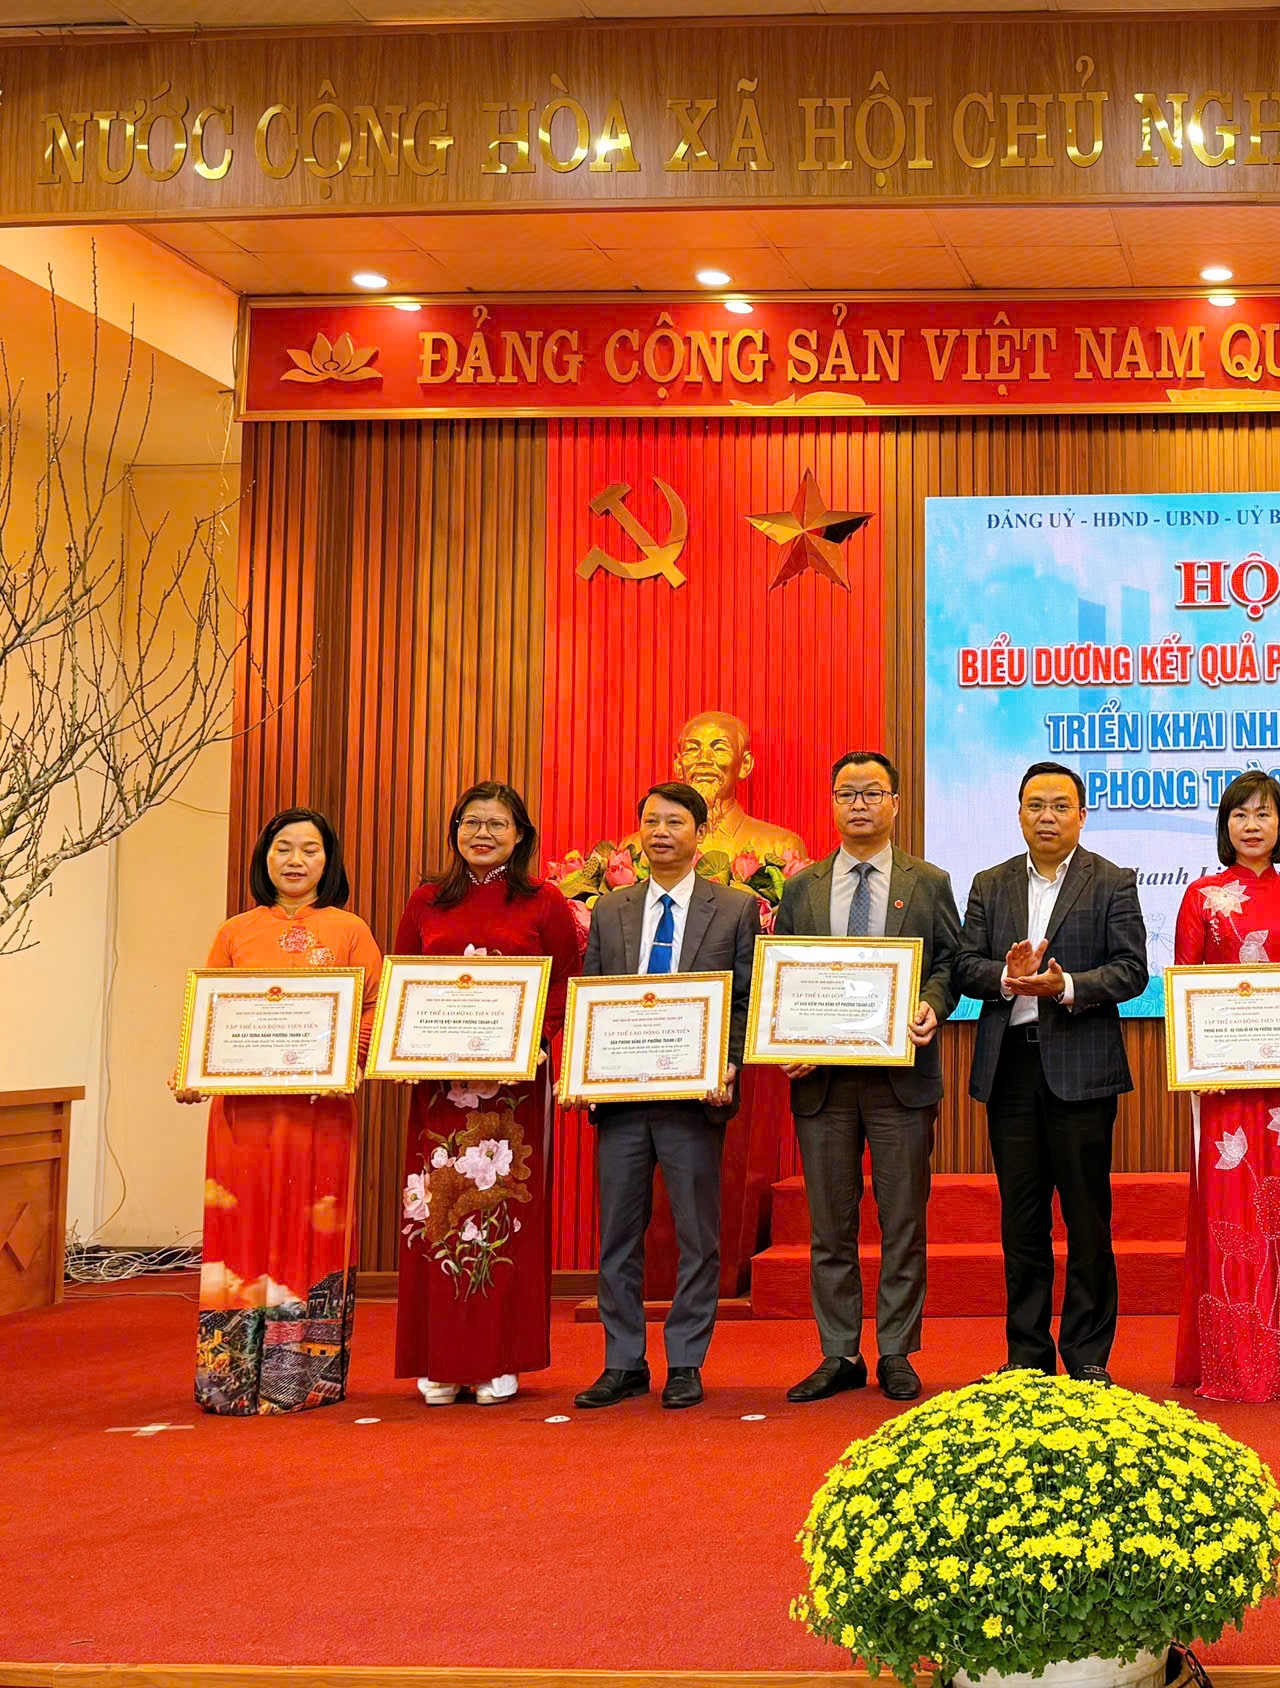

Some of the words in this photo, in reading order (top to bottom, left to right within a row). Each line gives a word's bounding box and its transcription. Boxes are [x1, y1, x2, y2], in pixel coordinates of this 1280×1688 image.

[37, 80, 234, 185] NƯỚC
[255, 79, 456, 200] CỘNG
[480, 74, 642, 175] HÒA
[664, 77, 775, 173] XÃ
[799, 70, 934, 189] HỘI
[953, 55, 1109, 168] CHỦ
[417, 305, 585, 385] ĐẢNG
[604, 311, 770, 398] CỘNG
[787, 302, 906, 383] SẢN
[921, 311, 1057, 397] VIỆT
[1075, 325, 1206, 379] NAM
[987, 509, 1043, 529] ĐẢNG
[1049, 507, 1076, 528] UỶ
[1092, 511, 1149, 527] HĐND
[1166, 510, 1220, 526] UBND
[1236, 504, 1264, 525] UỶ
[959, 632, 1025, 687] BIỂU
[1032, 642, 1132, 684] DƯƠNG
[1138, 633, 1194, 682] KẾT
[1198, 631, 1260, 687] QUẢ
[1045, 697, 1142, 754] TRIỂN
[1147, 708, 1226, 751] KHAI
[1085, 767, 1198, 810] PHONG
